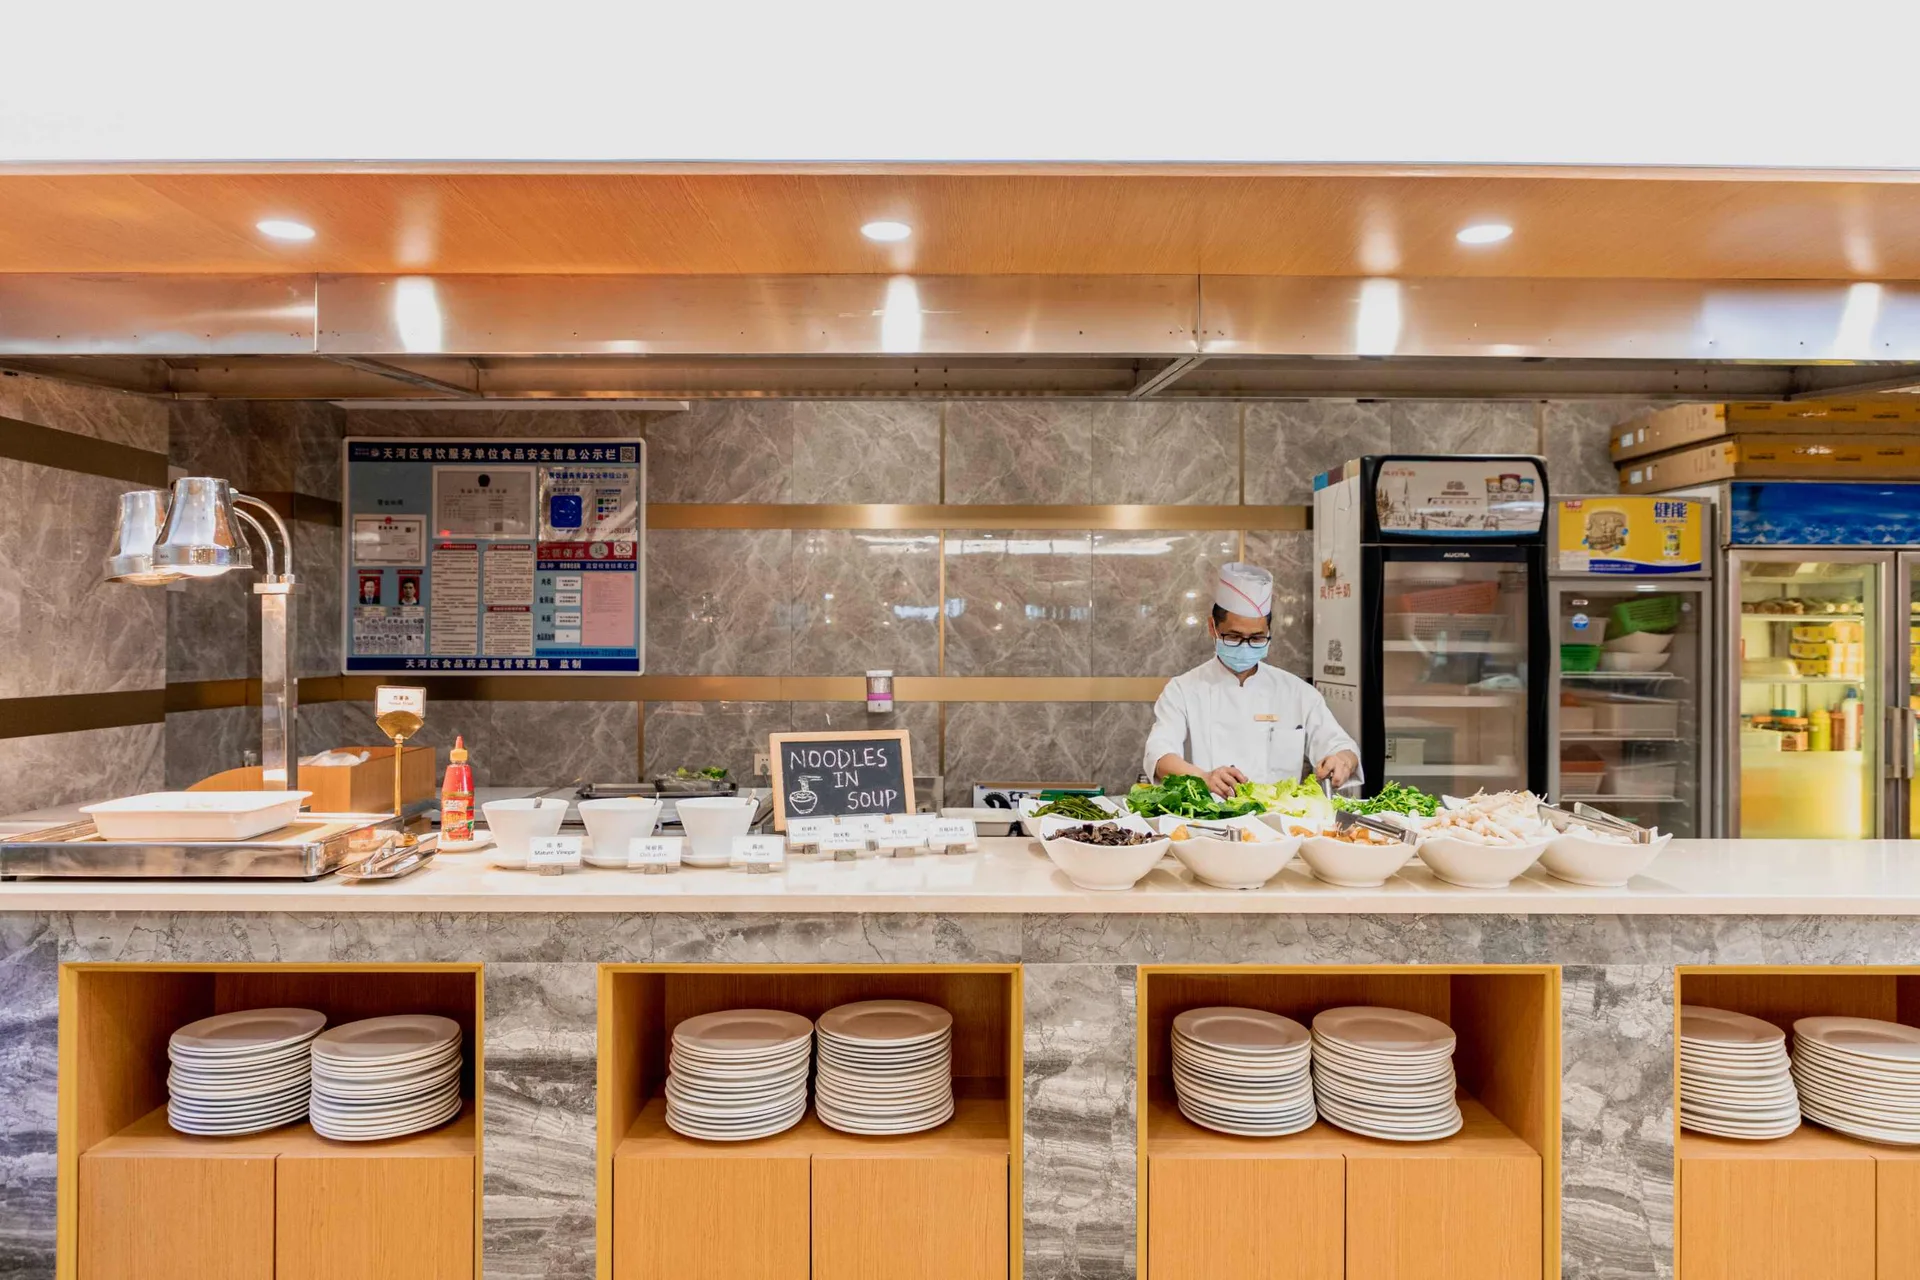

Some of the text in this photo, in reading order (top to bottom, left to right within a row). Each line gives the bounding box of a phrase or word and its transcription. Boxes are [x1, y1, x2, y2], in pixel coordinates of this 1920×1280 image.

[383, 447, 616, 460] 天河区餐饮服务单位食品安全信息公示栏
[1320, 583, 1351, 600] 风行牛奶
[405, 659, 582, 669] 天河区食品药品监督管理局 监制
[789, 747, 888, 770] NOODLES
[832, 771, 859, 789] IN
[847, 789, 898, 810] SOUP
